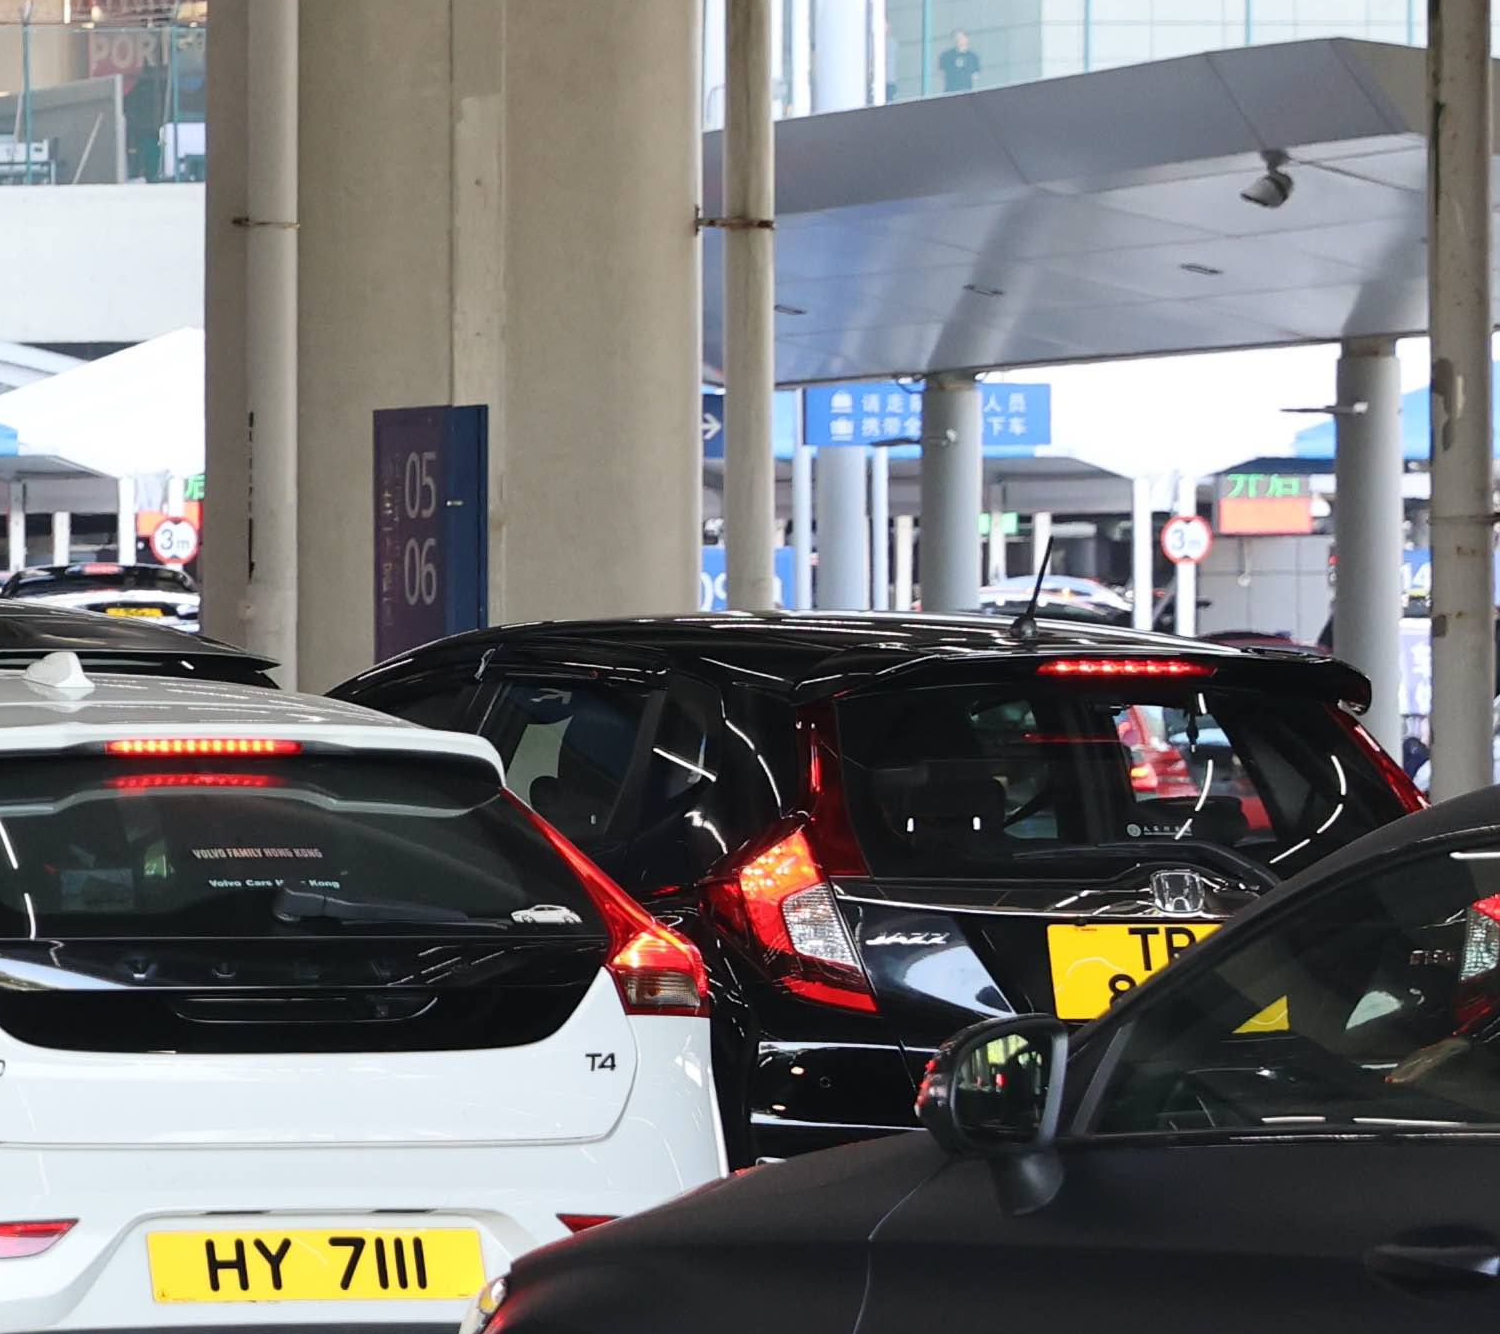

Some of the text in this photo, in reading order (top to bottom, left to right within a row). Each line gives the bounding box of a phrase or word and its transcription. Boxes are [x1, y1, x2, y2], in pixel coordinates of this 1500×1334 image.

[405, 452, 437, 519] 05
[404, 538, 437, 606] 06
[192, 848, 324, 859] VOLVO FAMILY HONG KONG
[208, 879, 242, 888] Volvo
[245, 879, 273, 887] Cars
[308, 879, 341, 889] Kong
[586, 1052, 618, 1073] T4
[204, 1235, 429, 1292] HY 7111
